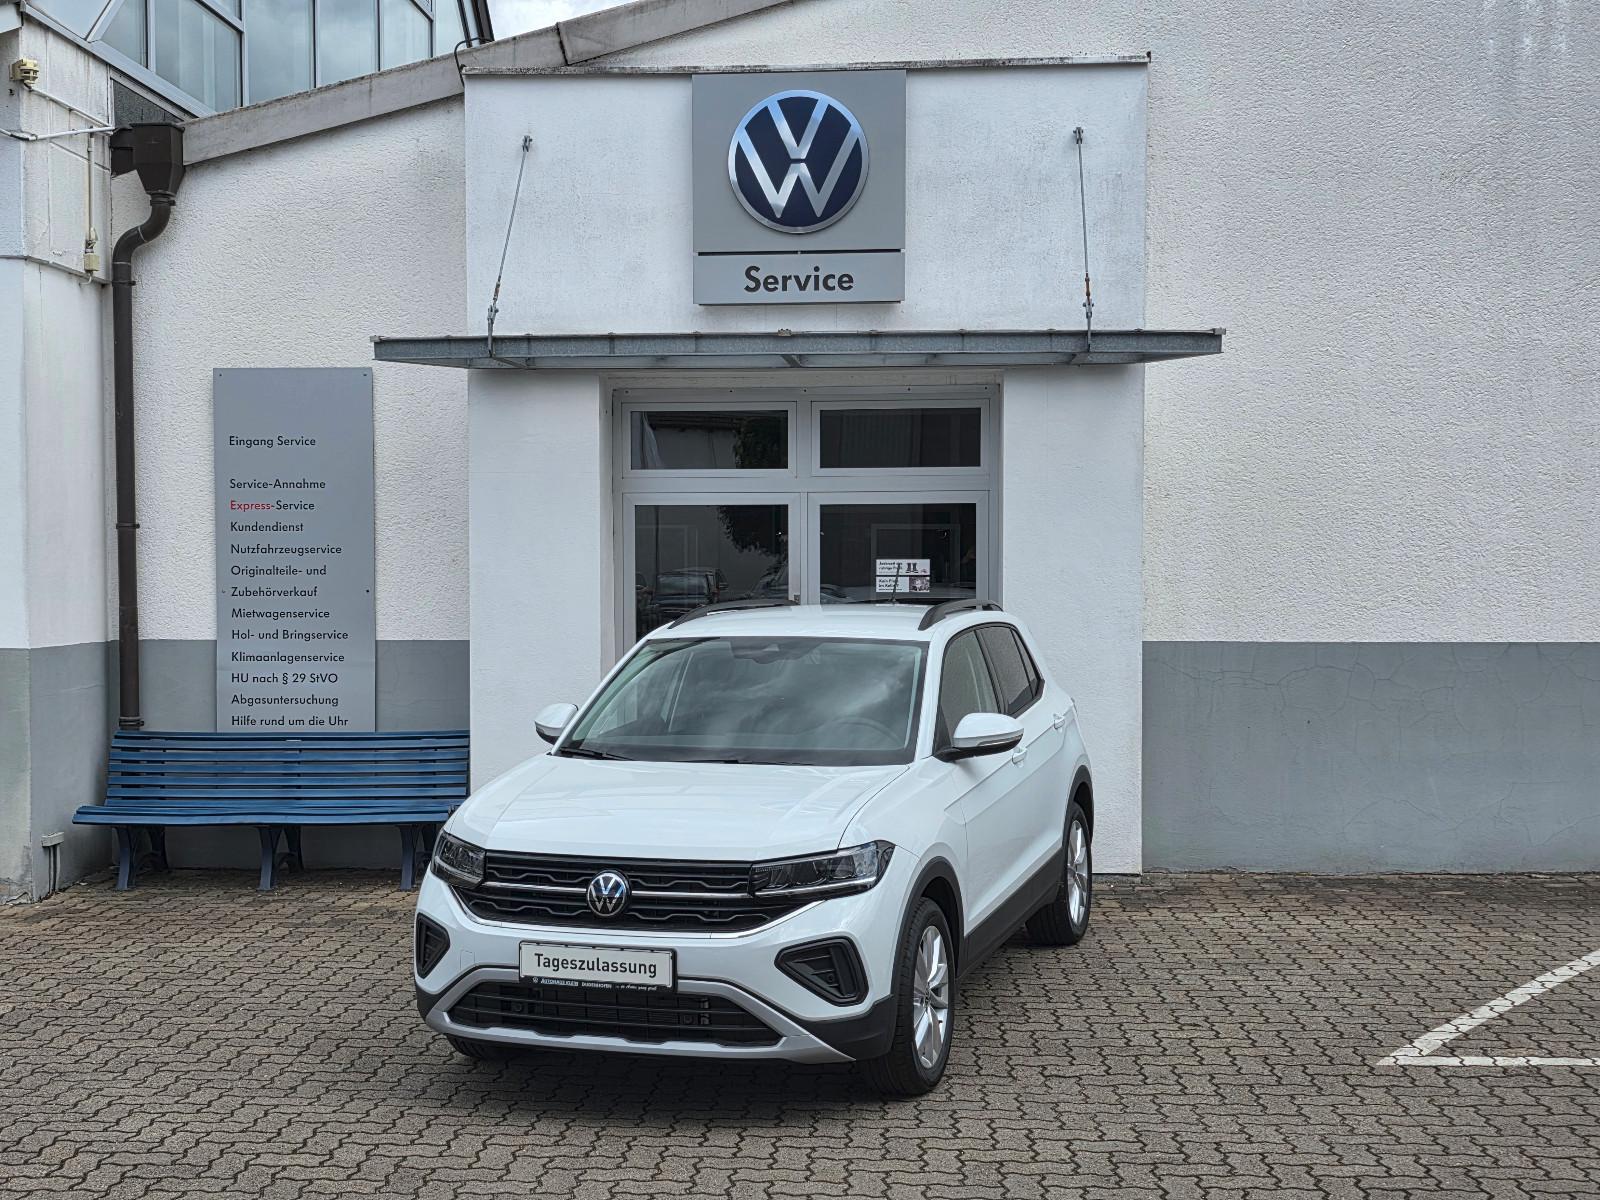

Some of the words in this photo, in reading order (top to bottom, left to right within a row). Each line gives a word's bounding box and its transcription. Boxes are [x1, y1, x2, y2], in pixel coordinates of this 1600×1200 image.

[744, 266, 854, 292] Service
[229, 435, 274, 449] Eingang
[277, 435, 316, 446] Service
[229, 478, 326, 489] Service-Annahme
[230, 499, 315, 512] Express-Service
[230, 521, 304, 532] Kundendienst
[230, 543, 342, 556] Nutzfahrzeugservice
[230, 564, 302, 577] Originalteile-
[306, 564, 327, 575] und
[231, 585, 318, 597] Zubehörverkauf
[231, 607, 330, 620] Mietwagenservice
[231, 629, 255, 640] Hol-
[258, 629, 279, 640] und
[282, 629, 349, 642] Bringservice
[231, 650, 345, 664] Klimaanlagenservice
[231, 673, 249, 683] HU
[252, 672, 279, 684] nach
[282, 673, 288, 685] §
[292, 673, 306, 683] 29
[310, 673, 338, 684] StVO
[231, 694, 339, 707] Abgasuntersuchung
[231, 715, 257, 726] Hilfe
[260, 715, 285, 726] rund
[288, 718, 305, 726] um
[308, 715, 325, 726] die
[328, 715, 349, 726] Uhr
[534, 953, 657, 978] Tageszulassung
